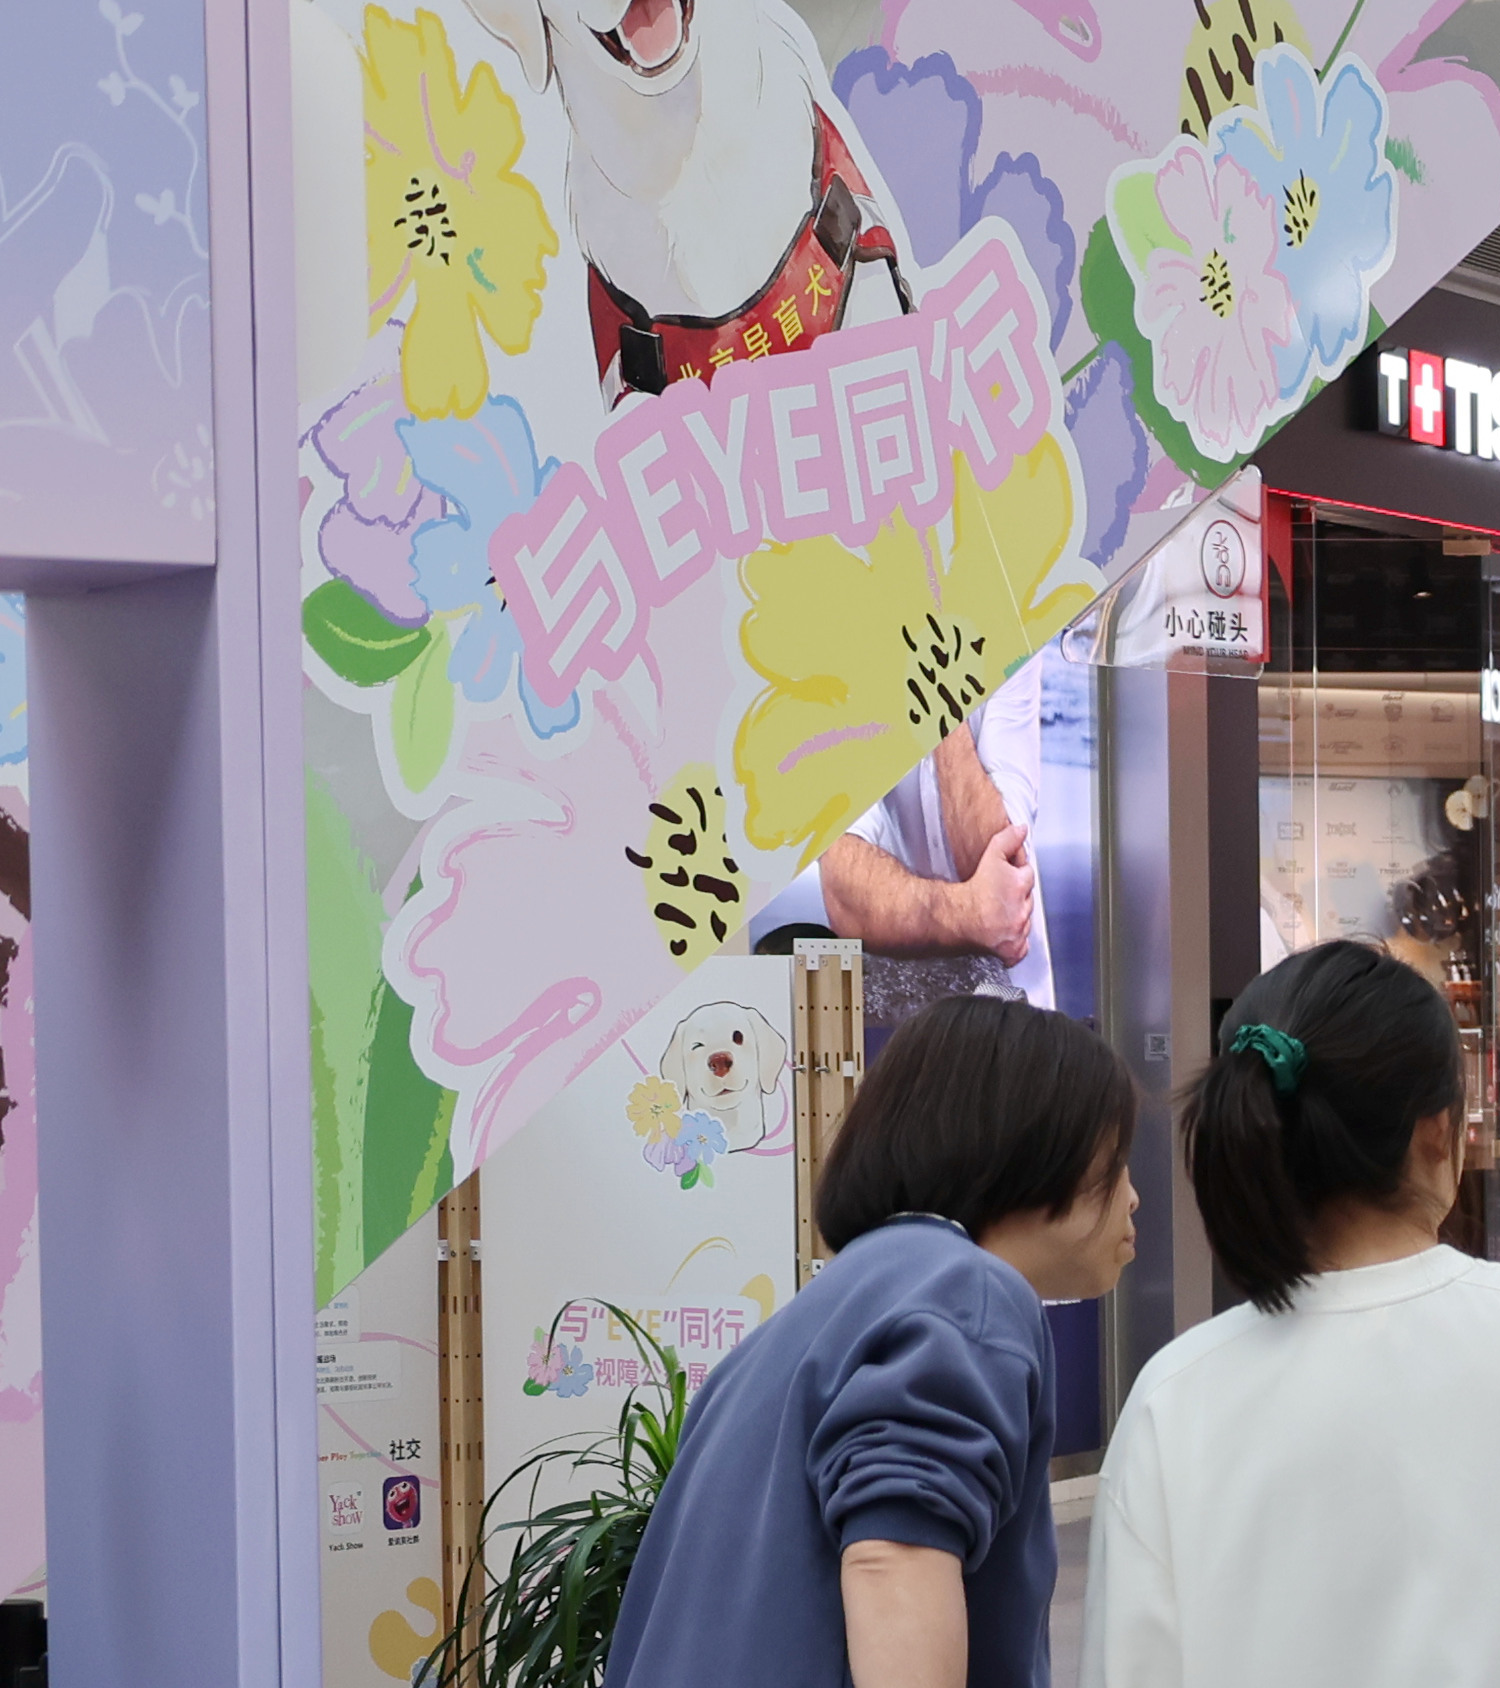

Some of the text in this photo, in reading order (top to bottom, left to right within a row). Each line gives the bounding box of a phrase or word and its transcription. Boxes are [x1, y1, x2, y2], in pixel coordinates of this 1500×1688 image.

[514, 257, 1036, 681] 与EYE同行
[1165, 606, 1248, 642] 小心碰头
[594, 1356, 709, 1391] 视障公展
[389, 1438, 422, 1461] 社交
